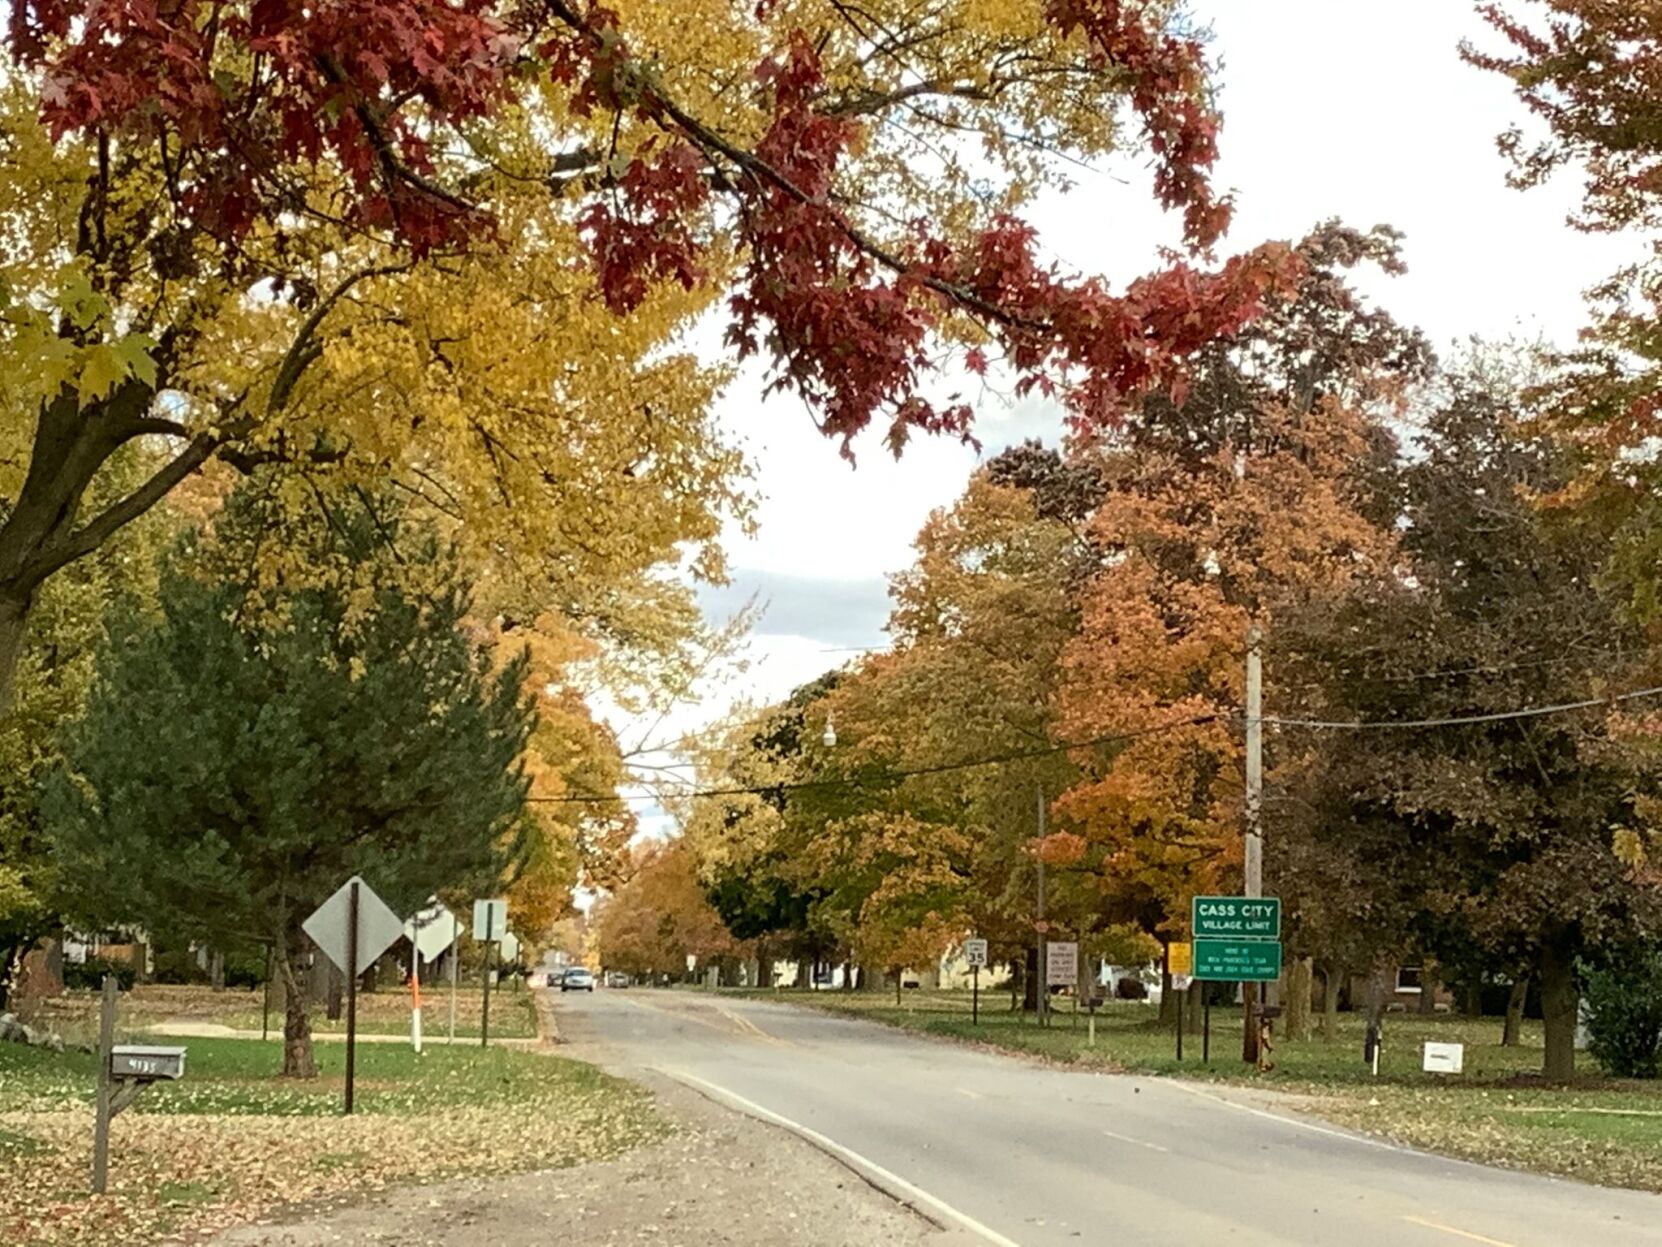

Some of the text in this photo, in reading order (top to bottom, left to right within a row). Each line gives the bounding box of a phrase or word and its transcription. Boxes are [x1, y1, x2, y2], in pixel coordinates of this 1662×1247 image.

[1199, 904, 1274, 917] CASS CITY
[1202, 921, 1271, 930] VILLAGE LIMIT
[968, 953, 985, 963] 35
